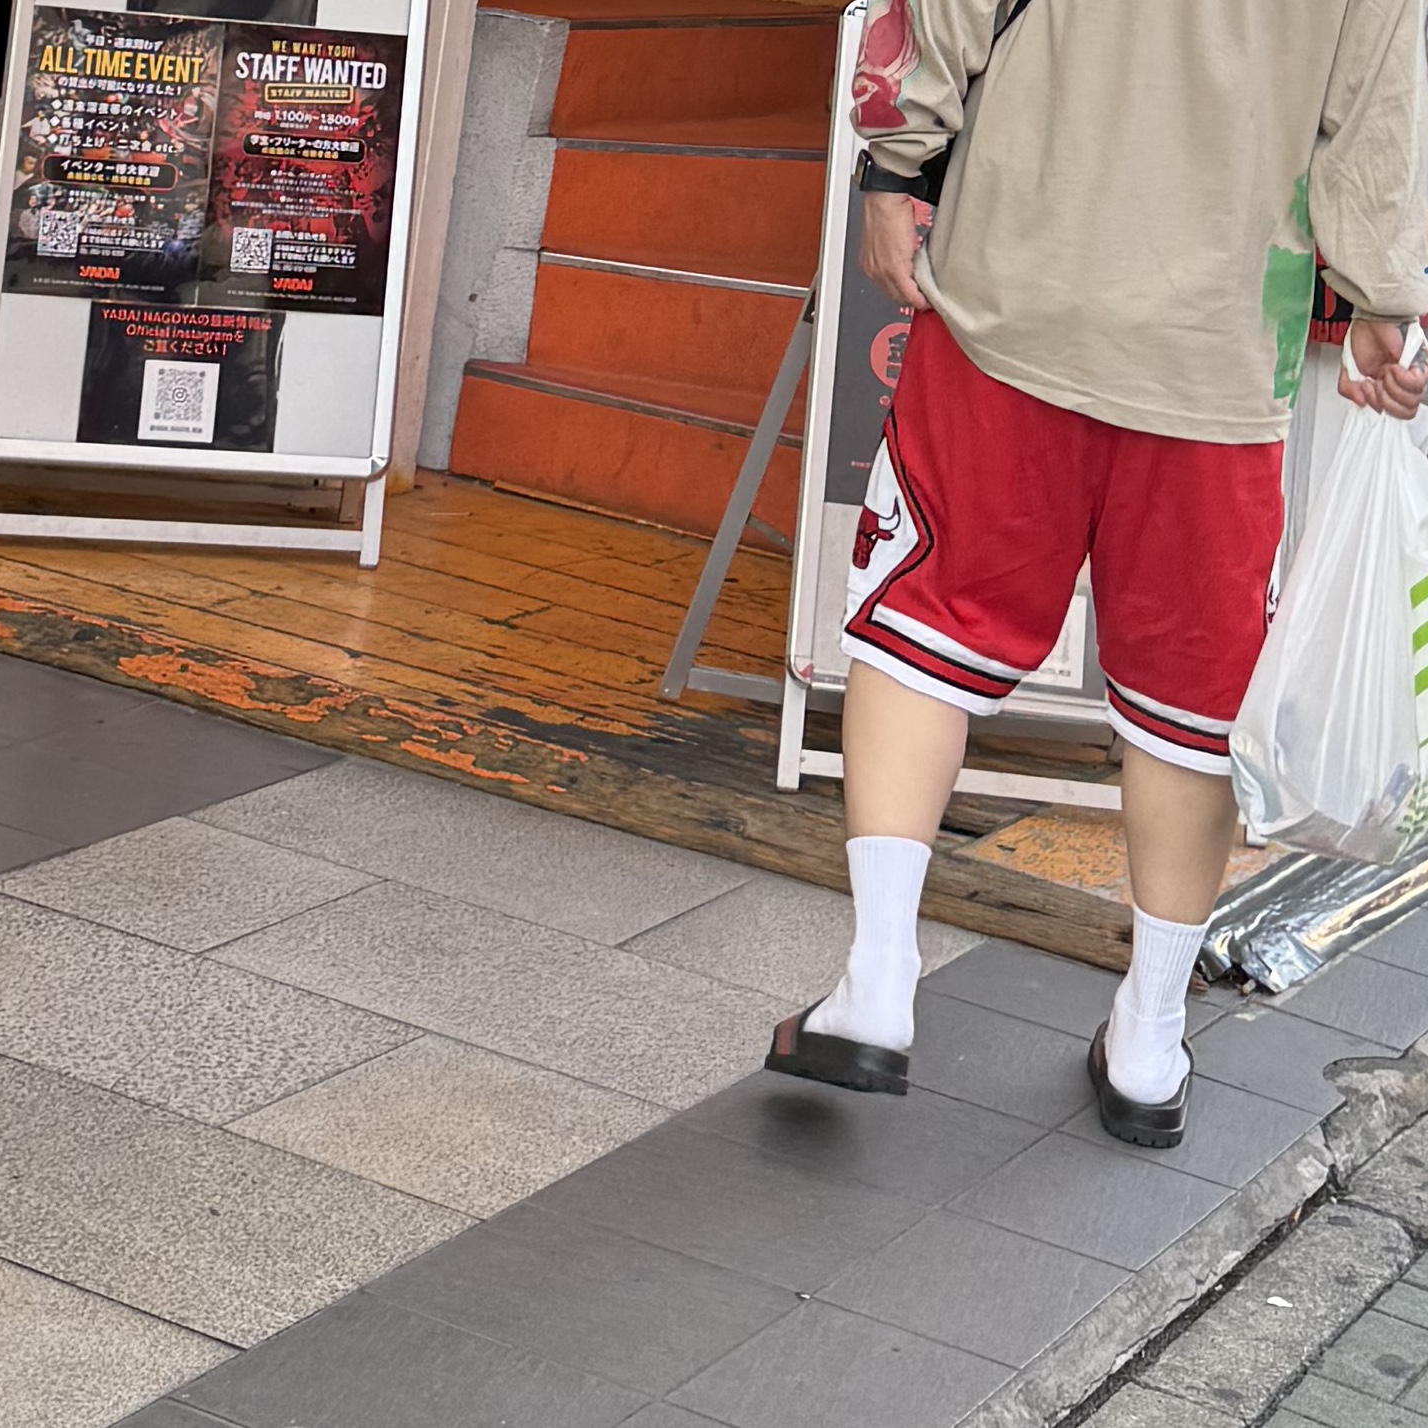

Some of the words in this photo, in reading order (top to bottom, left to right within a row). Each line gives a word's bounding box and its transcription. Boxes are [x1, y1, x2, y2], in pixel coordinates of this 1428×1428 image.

[40, 45, 78, 74] ALL
[84, 49, 133, 78] TIME
[134, 53, 204, 84] EVENT
[272, 40, 287, 53] WE
[293, 42, 322, 57] WANT
[235, 51, 302, 83] STAFF
[304, 56, 388, 90] WANTED
